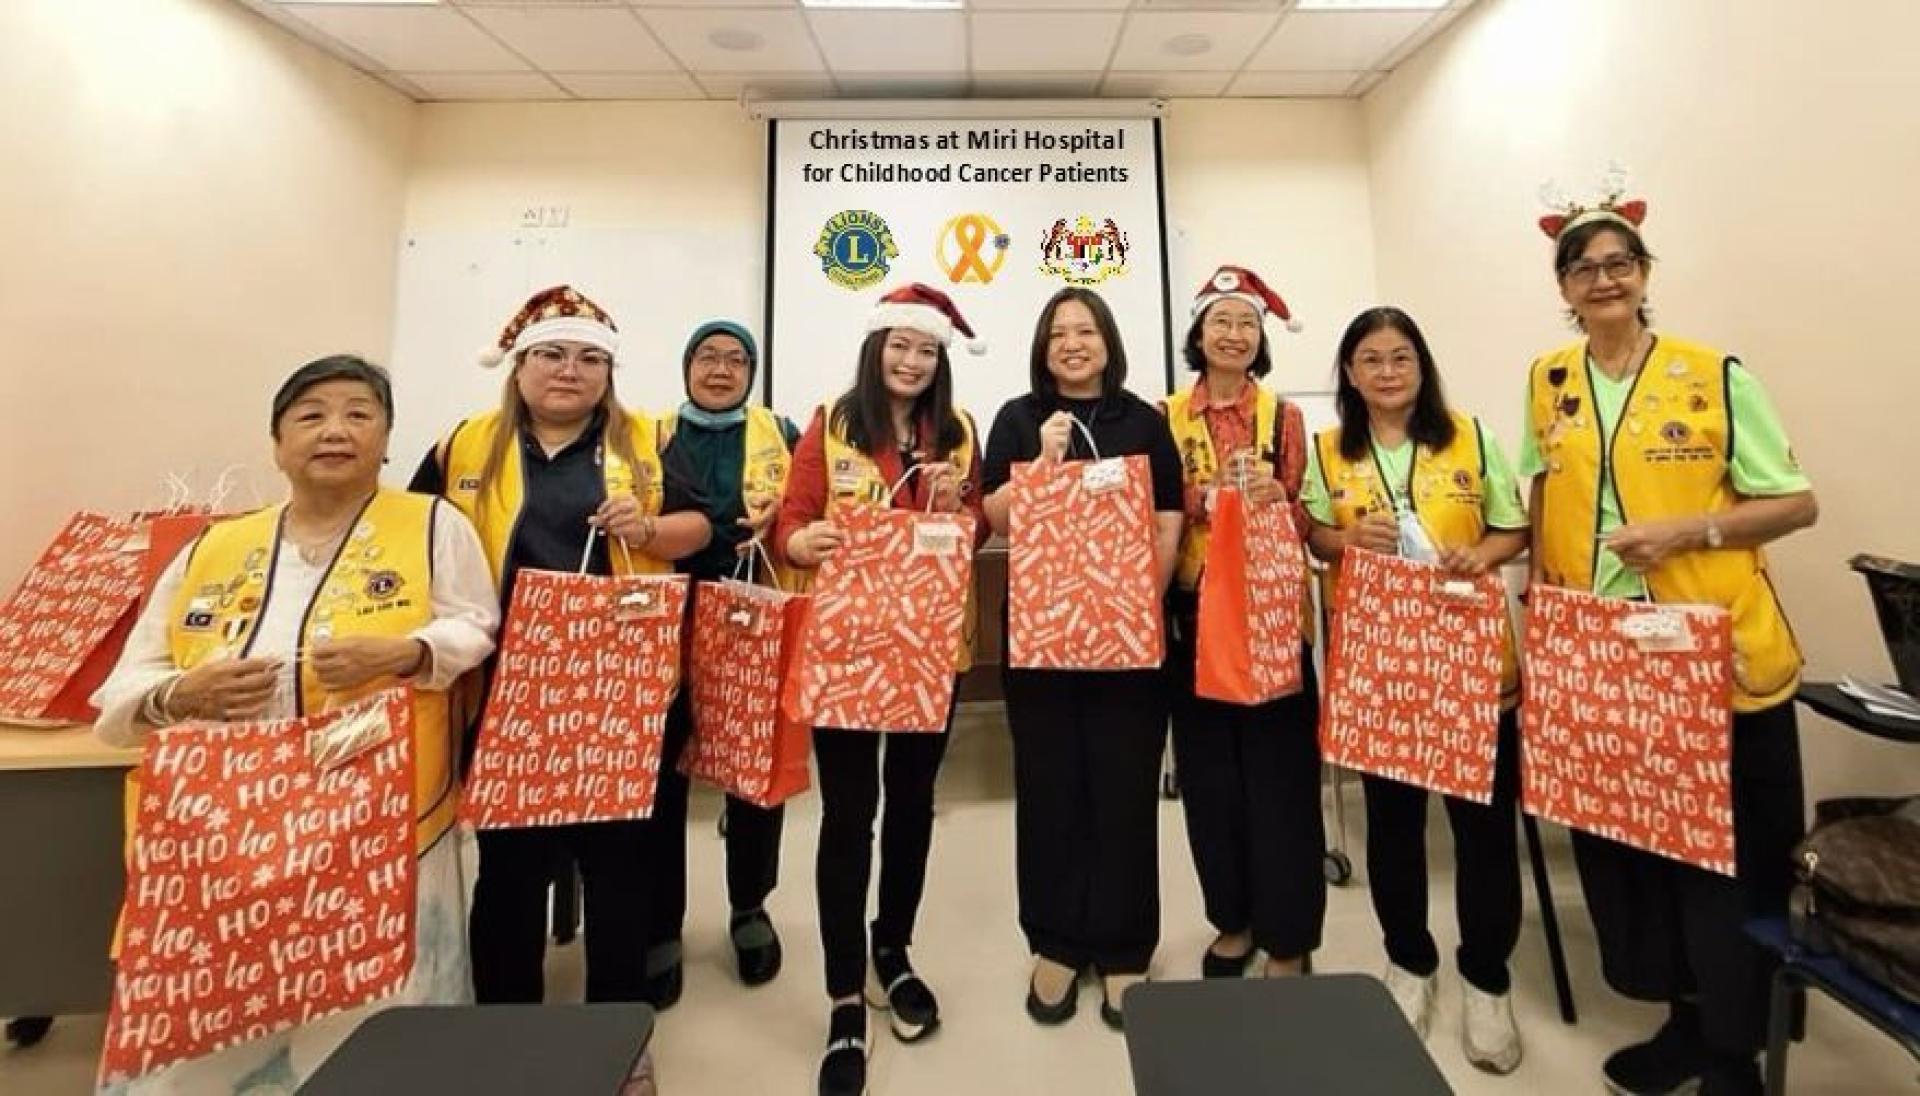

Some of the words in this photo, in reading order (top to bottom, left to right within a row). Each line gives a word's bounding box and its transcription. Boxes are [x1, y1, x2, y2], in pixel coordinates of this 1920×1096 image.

[810, 128, 929, 150] Christmas
[936, 131, 960, 150] at
[968, 128, 1017, 150] Miri
[1025, 128, 1125, 153] Hospital
[802, 163, 834, 183] for
[841, 161, 951, 183] Childhood
[959, 163, 1033, 183] Cancer
[1040, 161, 1128, 183] Patients
[848, 235, 868, 262] L
[522, 585, 553, 608] HO
[561, 591, 586, 615] ho
[1534, 598, 1566, 621] HO
[1576, 609, 1603, 632] ho
[525, 611, 553, 642] ho
[568, 617, 601, 641] HO
[618, 621, 645, 643] ho
[501, 650, 528, 677] ho
[529, 656, 560, 677] HO
[566, 649, 590, 679] ho
[595, 649, 621, 675] ho
[625, 656, 650, 677] HO
[656, 652, 674, 683] ho
[1545, 623, 1574, 655] ho
[1589, 640, 1623, 662] HO
[1646, 654, 1673, 678] ho
[498, 680, 529, 702] HO
[539, 683, 565, 709] ho
[594, 677, 626, 700] HO
[635, 683, 657, 707] ho
[1525, 652, 1553, 677] ho
[1557, 667, 1588, 692] HO
[1594, 669, 1621, 700] ho
[1624, 675, 1654, 703] ho
[1658, 692, 1693, 718] HO
[501, 704, 532, 741] ho
[548, 710, 582, 735] HO
[600, 702, 628, 734] ho
[1530, 680, 1561, 709] HO
[1570, 696, 1598, 723] ho
[1628, 706, 1664, 737] HO
[1676, 723, 1710, 750] ho
[153, 747, 206, 775] HO
[222, 747, 261, 779] ho
[476, 748, 504, 775] ho
[507, 752, 538, 777] HO
[545, 744, 571, 777] ho
[576, 742, 603, 770] ho
[607, 750, 636, 771] HO
[1541, 712, 1570, 744] ho
[1585, 732, 1621, 755] HO
[1644, 737, 1677, 775] ho
[165, 778, 213, 820] ho
[238, 773, 288, 808] HO
[317, 767, 355, 794] ho
[470, 779, 507, 805] HO
[517, 781, 545, 809] ho
[575, 773, 607, 797] HO
[618, 777, 644, 798] ho
[1523, 738, 1551, 768] ho
[1555, 758, 1587, 783] HO
[1593, 763, 1620, 793] ho
[1622, 770, 1656, 797] ho
[1660, 789, 1699, 815] HO
[1530, 770, 1563, 798] HO
[1573, 787, 1603, 813] ho
[1631, 801, 1669, 832] HO
[1681, 819, 1716, 849] ho
[135, 836, 176, 871] ho
[181, 836, 227, 868] HO
[237, 819, 276, 856] ho
[284, 810, 324, 845] ho
[329, 800, 371, 835] HO
[138, 875, 186, 906] HO
[201, 873, 241, 910] ho
[284, 845, 333, 878] HO
[350, 835, 387, 868] ho
[152, 910, 194, 957] ho
[218, 901, 270, 942] HO
[304, 877, 345, 919] ho
[118, 970, 162, 1011] ho
[166, 967, 213, 1004] HO
[224, 951, 263, 990] ho
[270, 936, 314, 973] ho
[320, 923, 366, 962] HO
[120, 1013, 172, 1049] HO
[189, 1006, 232, 1042] ho
[277, 969, 326, 1004] HO
[344, 953, 383, 993] ho
